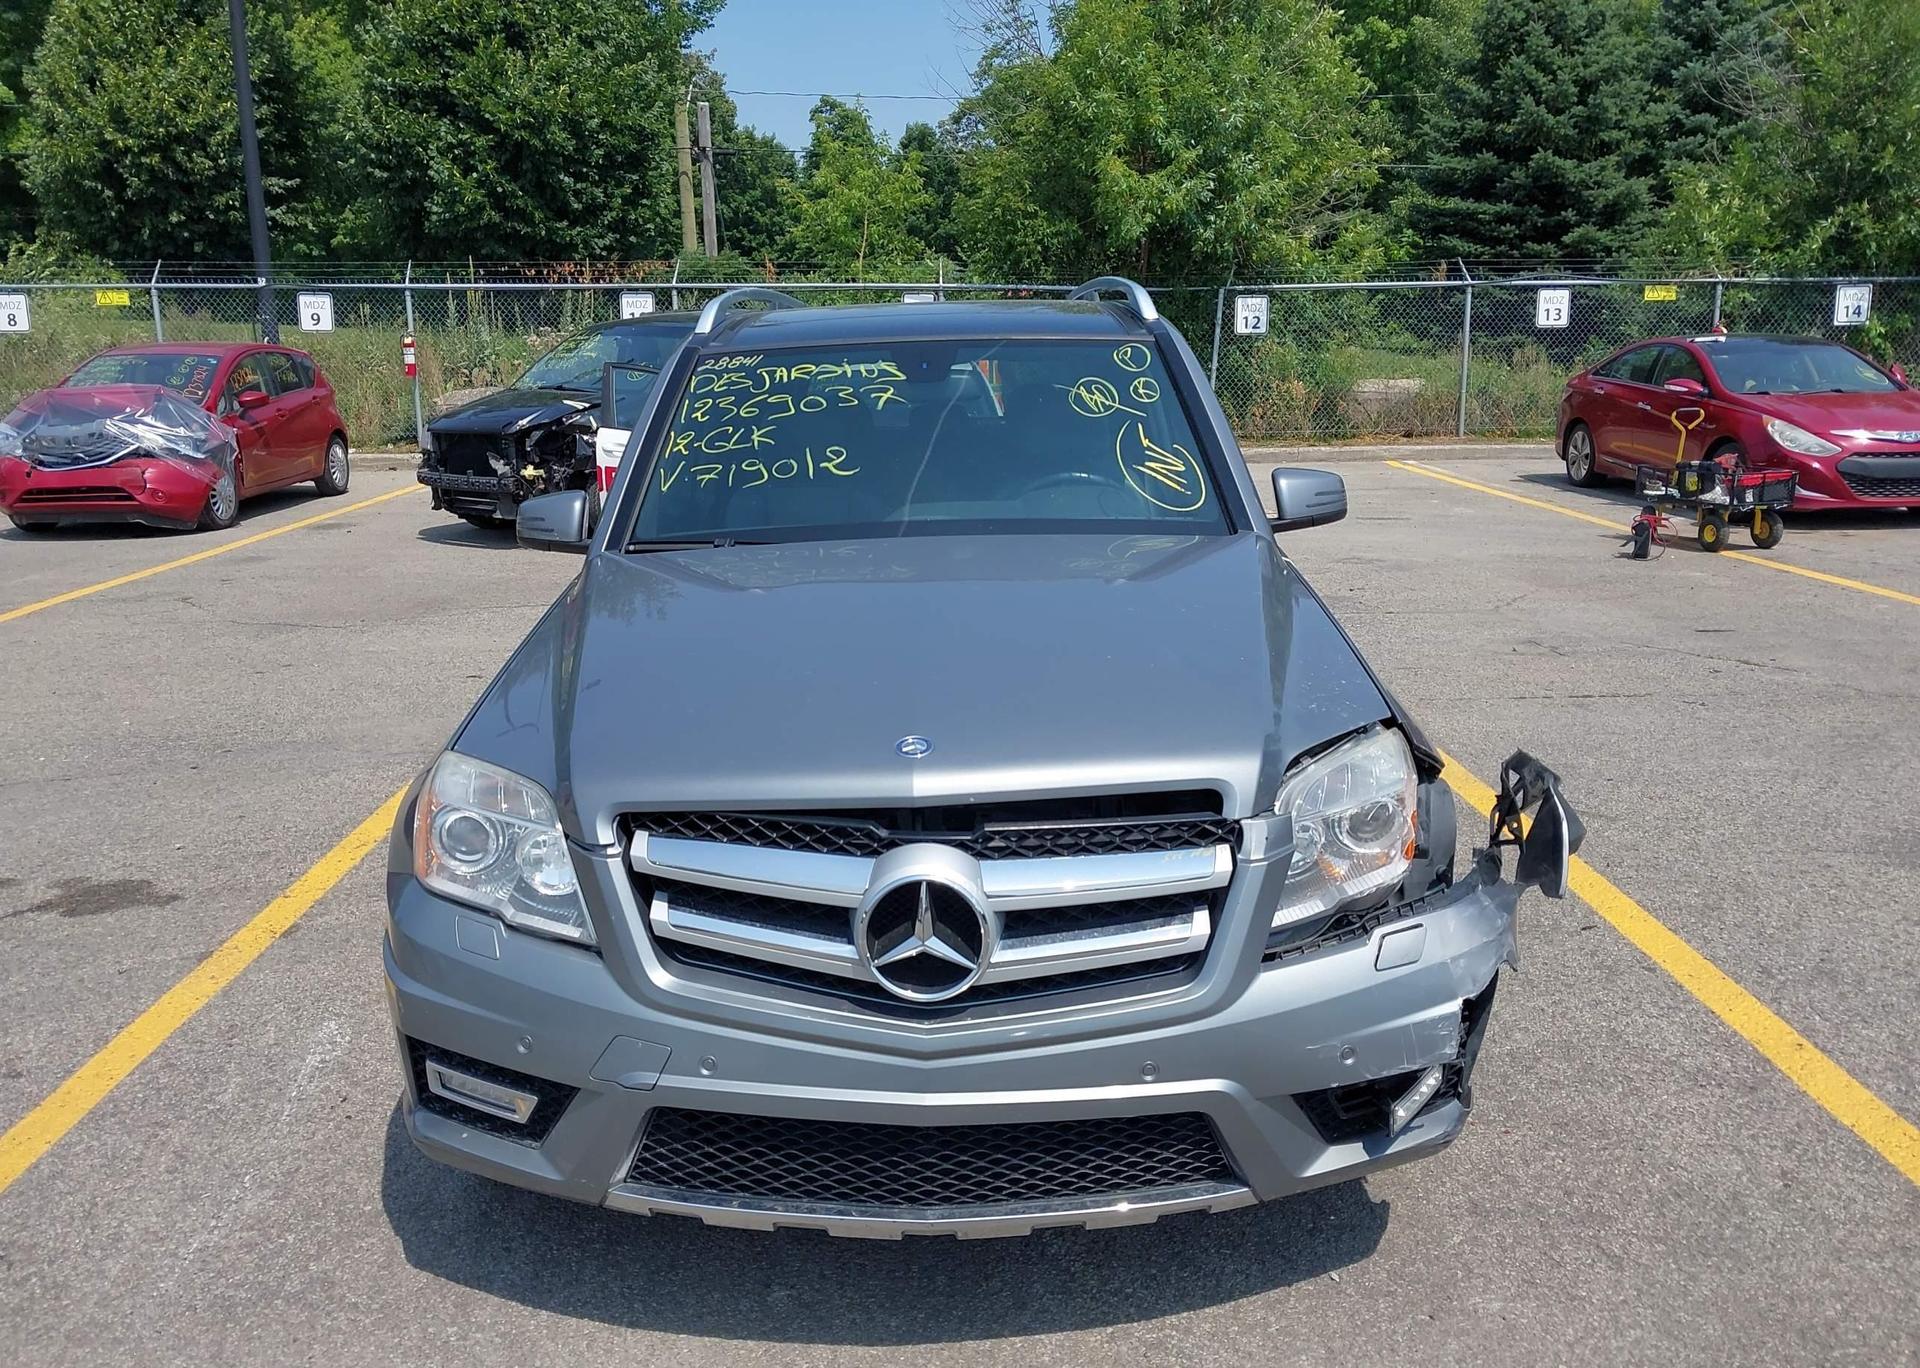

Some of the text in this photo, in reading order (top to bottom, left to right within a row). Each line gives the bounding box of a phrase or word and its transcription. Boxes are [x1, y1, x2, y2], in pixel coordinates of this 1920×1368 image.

[1543, 295, 1565, 305] MDZ
[1843, 292, 1865, 302] MDZ
[0, 301, 21, 310] MDZ
[303, 301, 326, 310] MDZ
[626, 299, 648, 309] MDZ
[1241, 303, 1263, 313] MDZ
[1544, 307, 1561, 321] 13
[1844, 305, 1862, 318] 14
[7, 313, 17, 327] 8
[310, 312, 321, 326] 9
[1243, 315, 1261, 330] 12
[697, 354, 764, 371] 28841
[680, 384, 912, 424] 12369037
